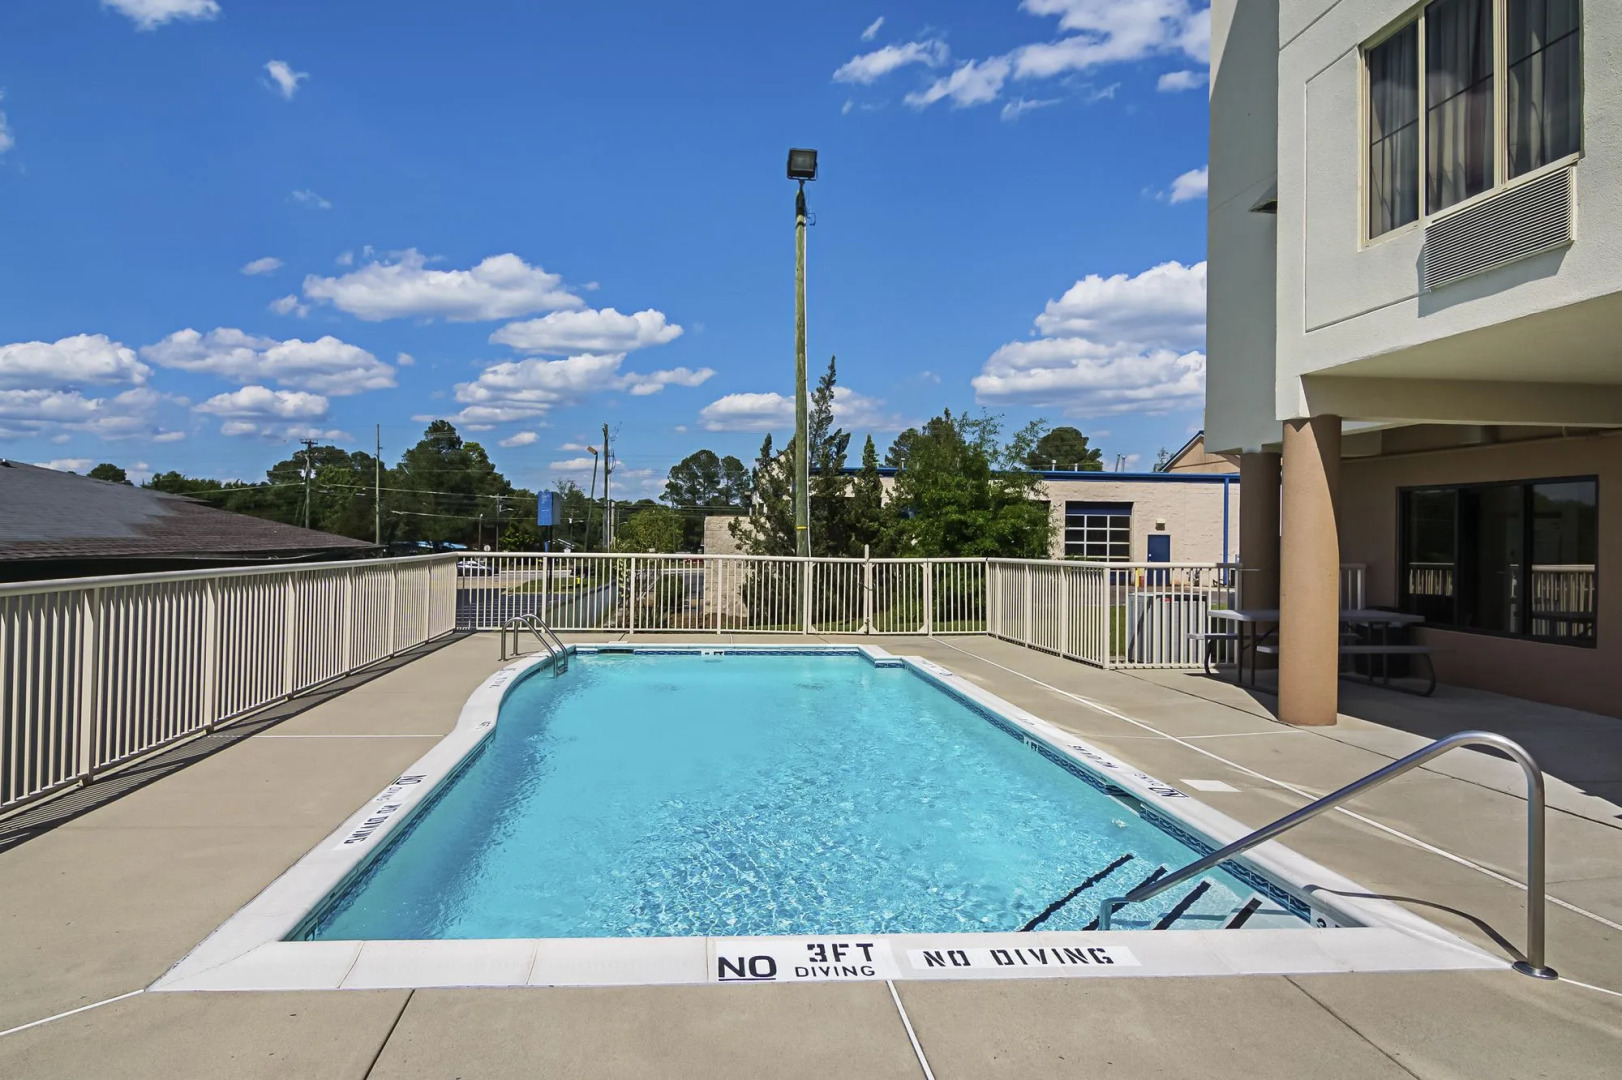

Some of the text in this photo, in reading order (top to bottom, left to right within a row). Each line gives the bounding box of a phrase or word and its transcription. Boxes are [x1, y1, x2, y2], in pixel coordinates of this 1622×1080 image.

[807, 943, 874, 963] 3FT
[923, 948, 1114, 967] NO DIVING
[718, 955, 875, 978] NO DIVING
